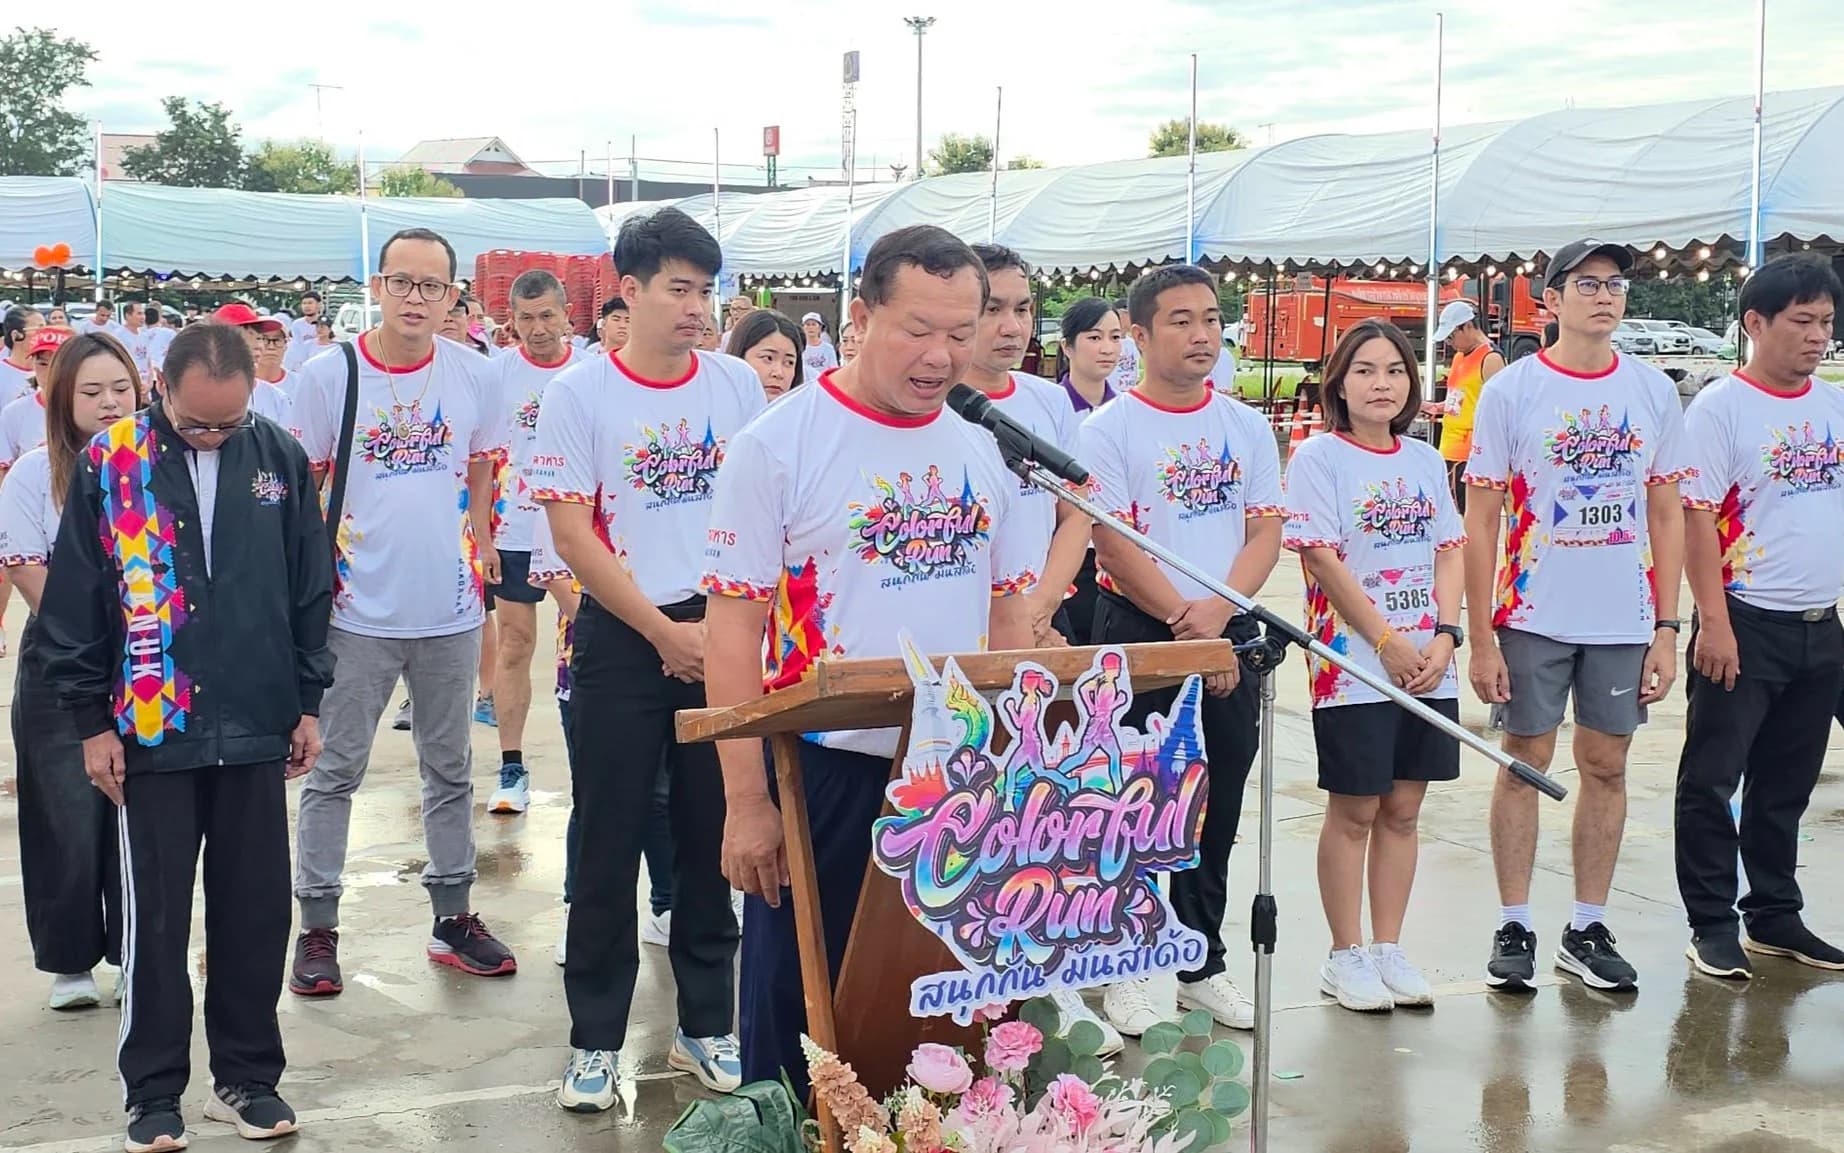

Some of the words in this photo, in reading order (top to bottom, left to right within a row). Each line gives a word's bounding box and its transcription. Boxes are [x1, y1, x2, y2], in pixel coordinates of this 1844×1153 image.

[1553, 432, 1632, 460] Colorful
[632, 447, 717, 484] Colorful
[1167, 462, 1234, 495] Colorful
[1580, 453, 1613, 473] Run
[663, 473, 694, 498] Run
[1191, 488, 1218, 509] Run
[862, 503, 979, 554] Colorful
[1579, 504, 1622, 525] 1303
[905, 539, 951, 572] Run
[1385, 588, 1430, 611] 5385
[881, 764, 1204, 908] Colorful
[988, 866, 1118, 965] Run
[919, 953, 1046, 1017] สนุกกัน
